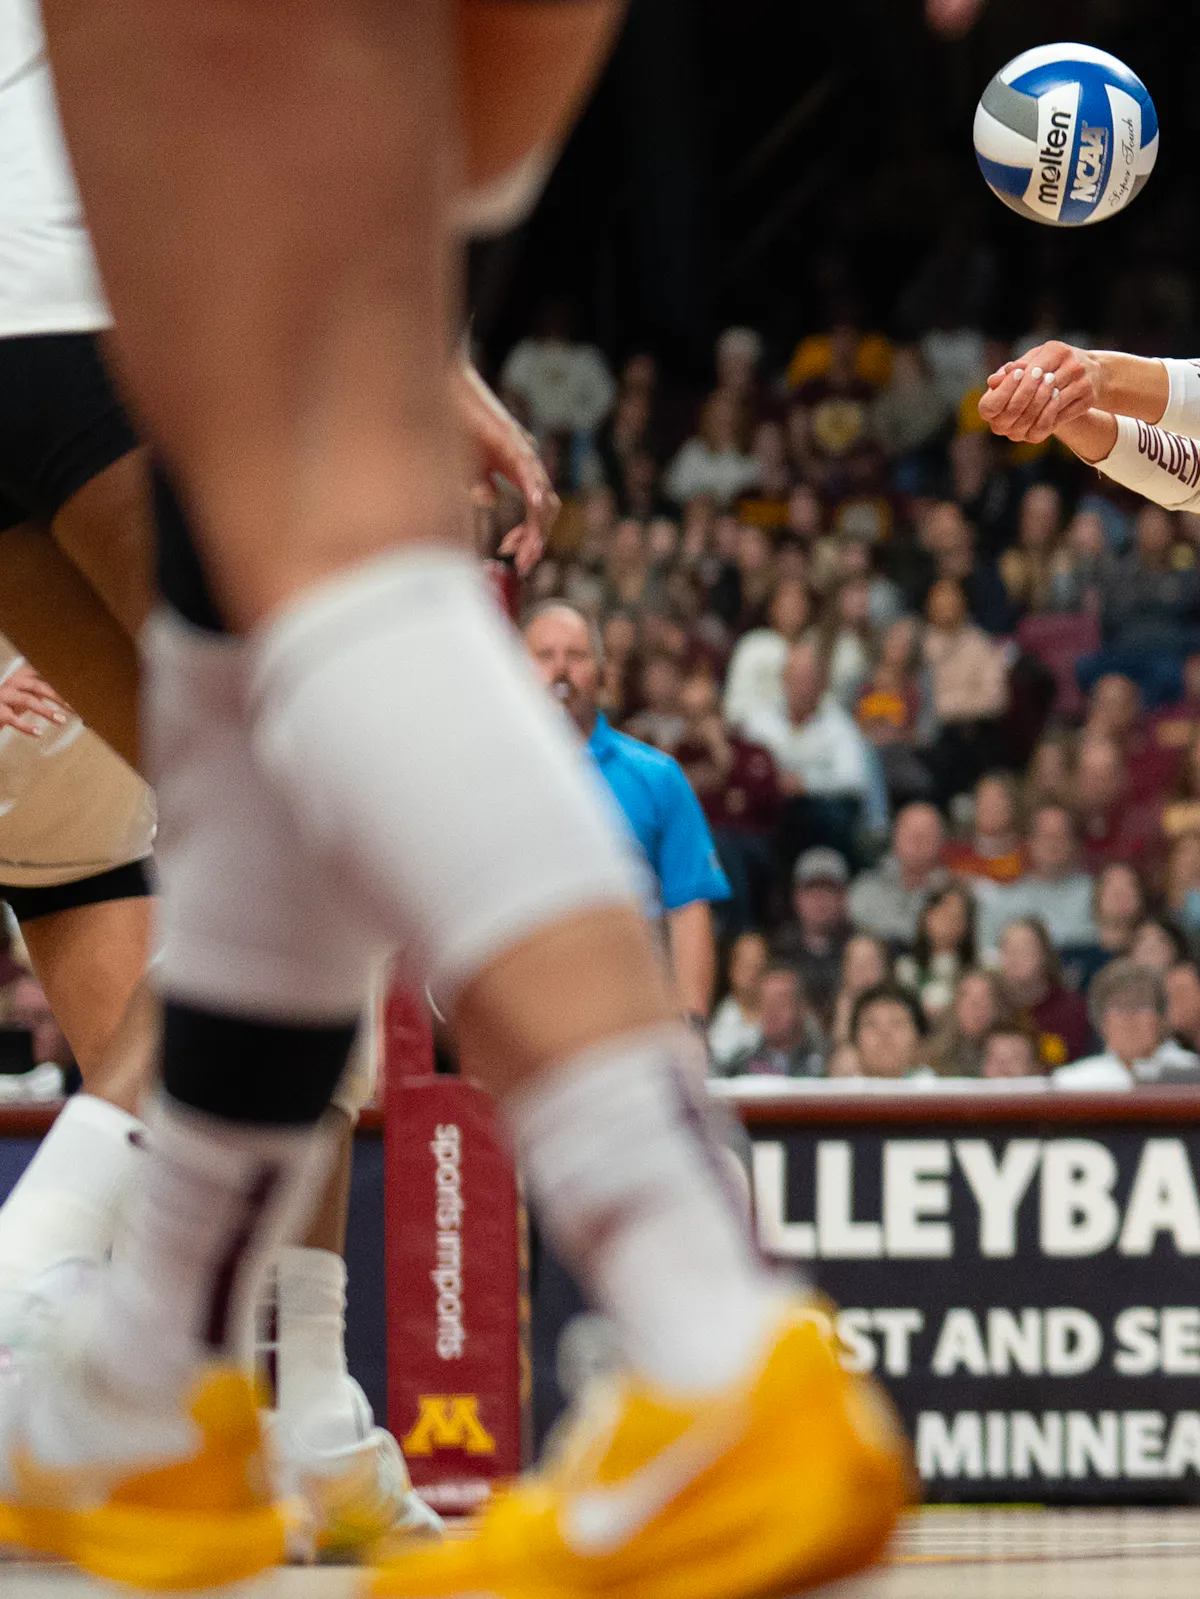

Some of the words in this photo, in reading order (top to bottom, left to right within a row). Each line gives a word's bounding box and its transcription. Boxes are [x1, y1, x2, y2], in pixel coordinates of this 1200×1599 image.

[1038, 111, 1072, 206] molten
[1070, 127, 1107, 203] NCAA
[1109, 170, 1131, 207] Super
[1121, 118, 1133, 166] Touch
[931, 1308, 1102, 1377] AND
